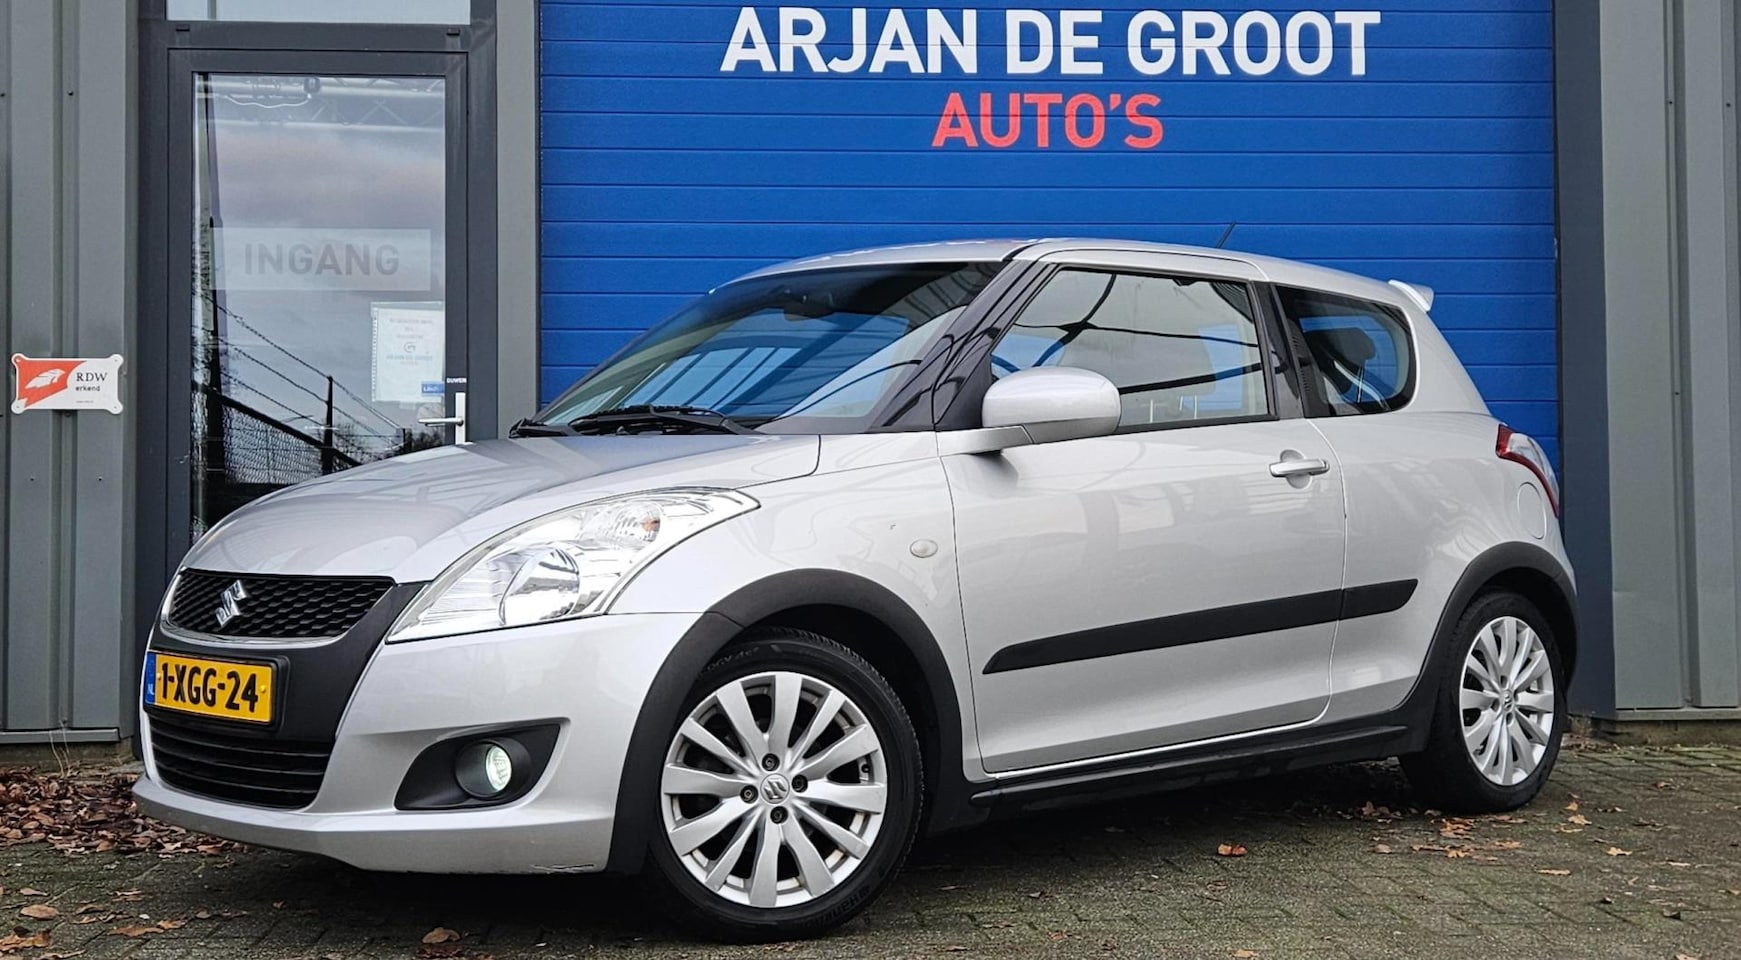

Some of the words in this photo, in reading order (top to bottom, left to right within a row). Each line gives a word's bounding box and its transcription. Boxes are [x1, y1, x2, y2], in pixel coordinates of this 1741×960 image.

[720, 7, 978, 74] ARJAN
[1006, 9, 1103, 75] DE
[1127, 10, 1382, 77] GROOT
[931, 92, 1164, 149] AUTO'S
[244, 243, 400, 276] INGANG
[76, 372, 107, 382] RDW
[161, 662, 259, 713] 1-XGG-24
